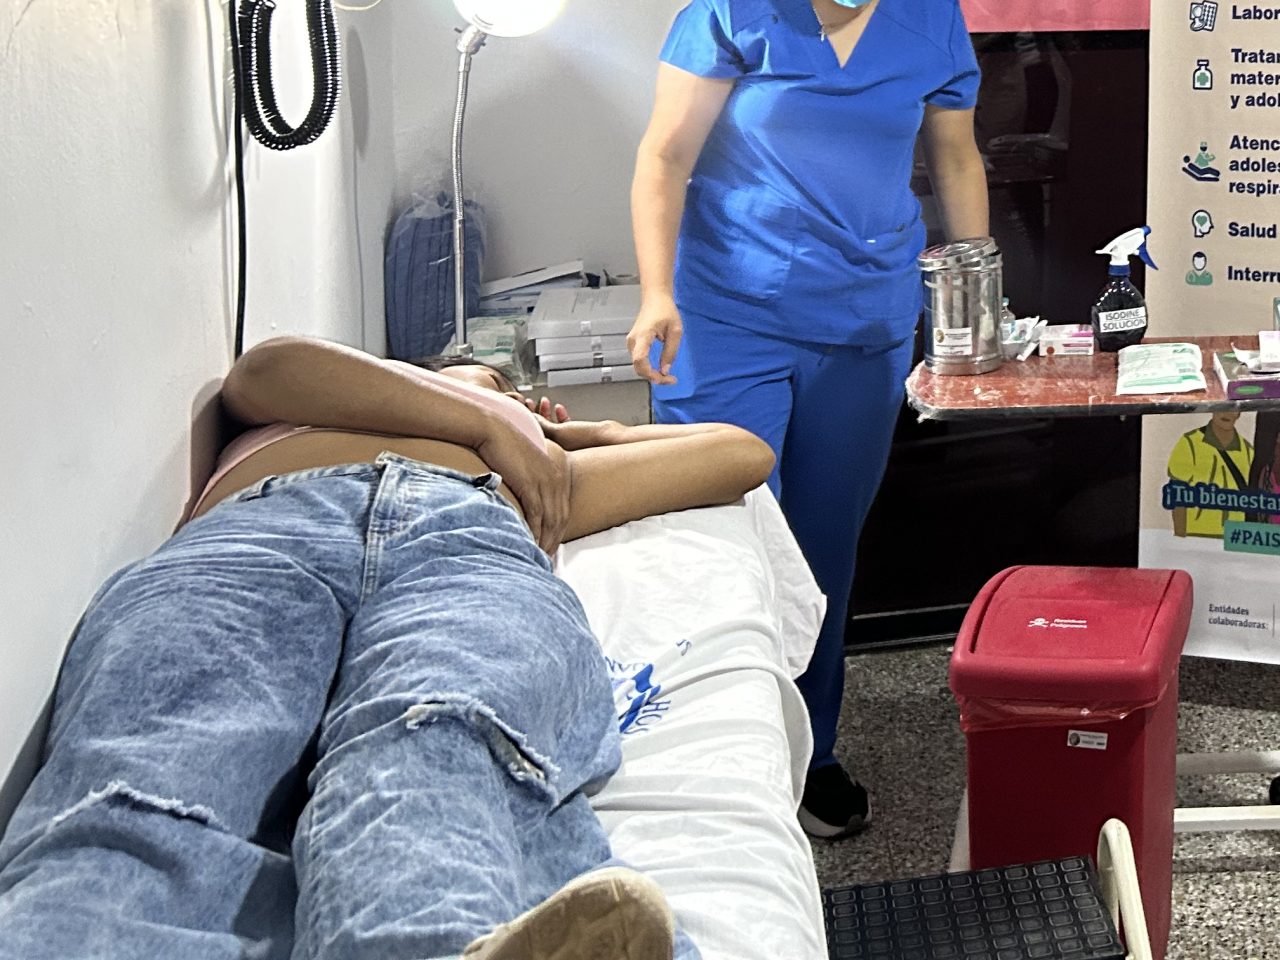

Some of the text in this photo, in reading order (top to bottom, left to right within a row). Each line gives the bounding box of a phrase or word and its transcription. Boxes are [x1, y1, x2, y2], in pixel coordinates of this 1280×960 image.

[1230, 94, 1240, 109] y
[1228, 221, 1277, 239] Salud
[1106, 309, 1140, 321] ISODINE
[1166, 485, 1193, 506] ¡Tu
[1208, 603, 1249, 616] Entidades
